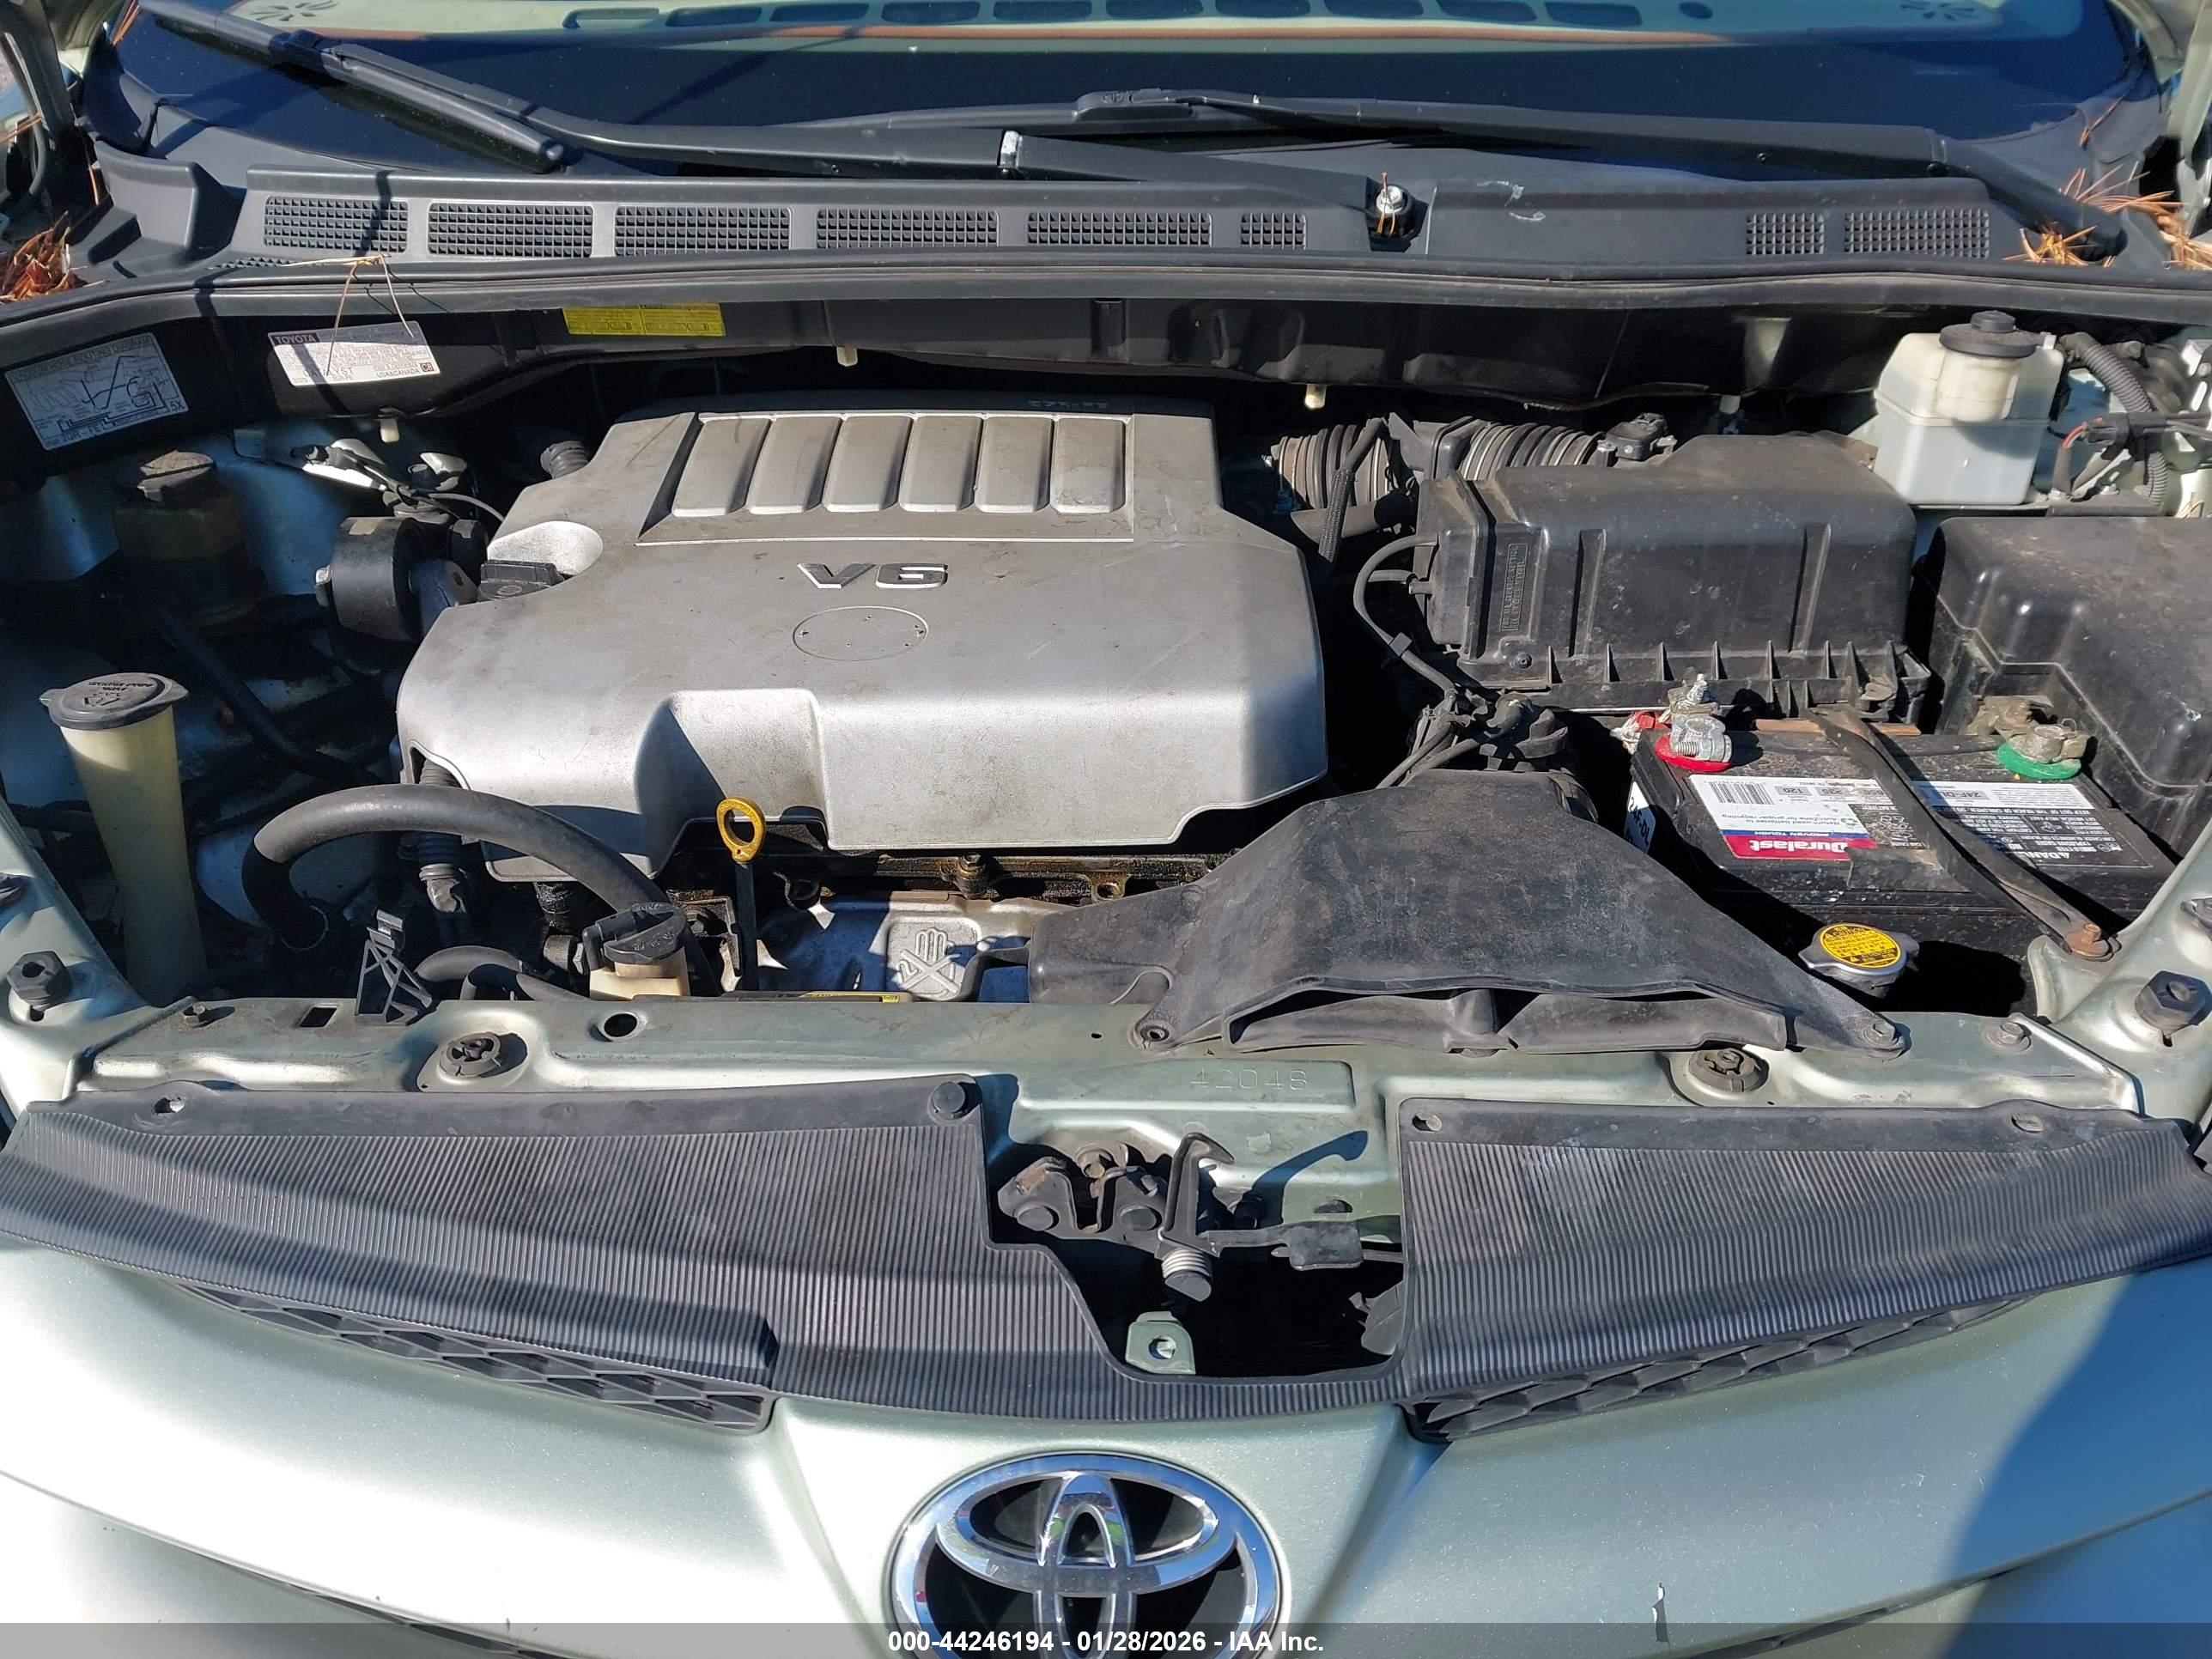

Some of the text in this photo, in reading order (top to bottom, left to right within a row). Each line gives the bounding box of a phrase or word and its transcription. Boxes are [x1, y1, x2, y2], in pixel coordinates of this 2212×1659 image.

[274, 335, 316, 343] TOYOTA
[171, 399, 185, 412] 5X
[797, 563, 948, 588] V6
[1630, 797, 1650, 846] 24F-DL
[1748, 840, 1847, 853] Duralast
[1833, 927, 1865, 937] CAUTION
[1190, 1068, 1308, 1091] 42048
